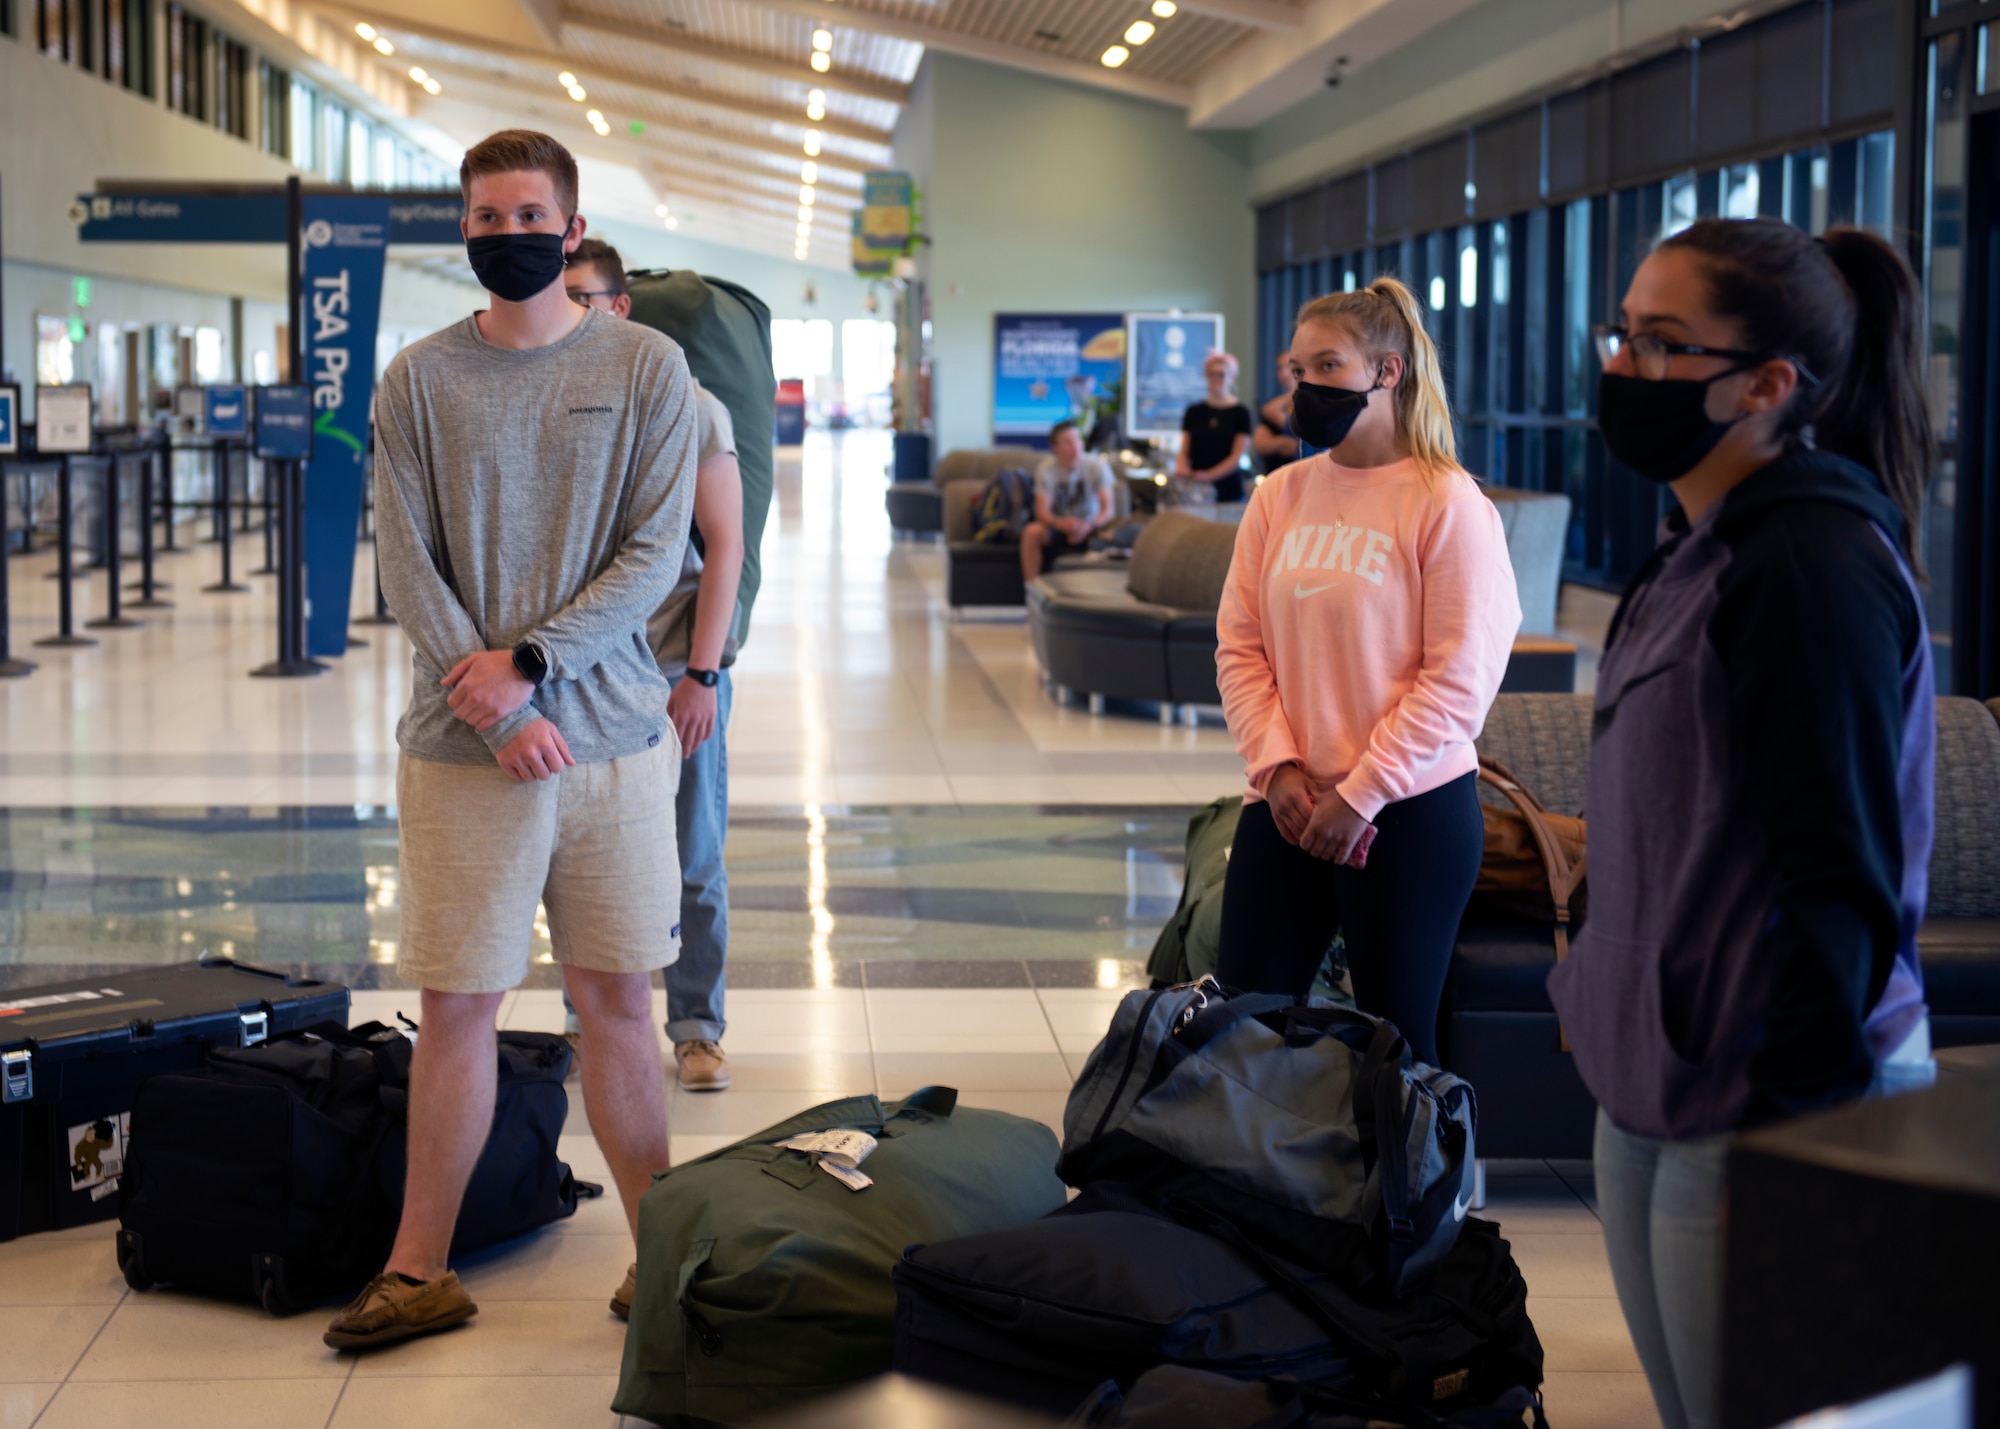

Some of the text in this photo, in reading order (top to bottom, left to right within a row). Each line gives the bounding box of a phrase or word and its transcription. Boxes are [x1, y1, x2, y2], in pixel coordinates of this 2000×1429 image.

[312, 268, 351, 410] TSA Pre
[568, 404, 613, 415] patagonia
[1272, 525, 1394, 587] NIKE
